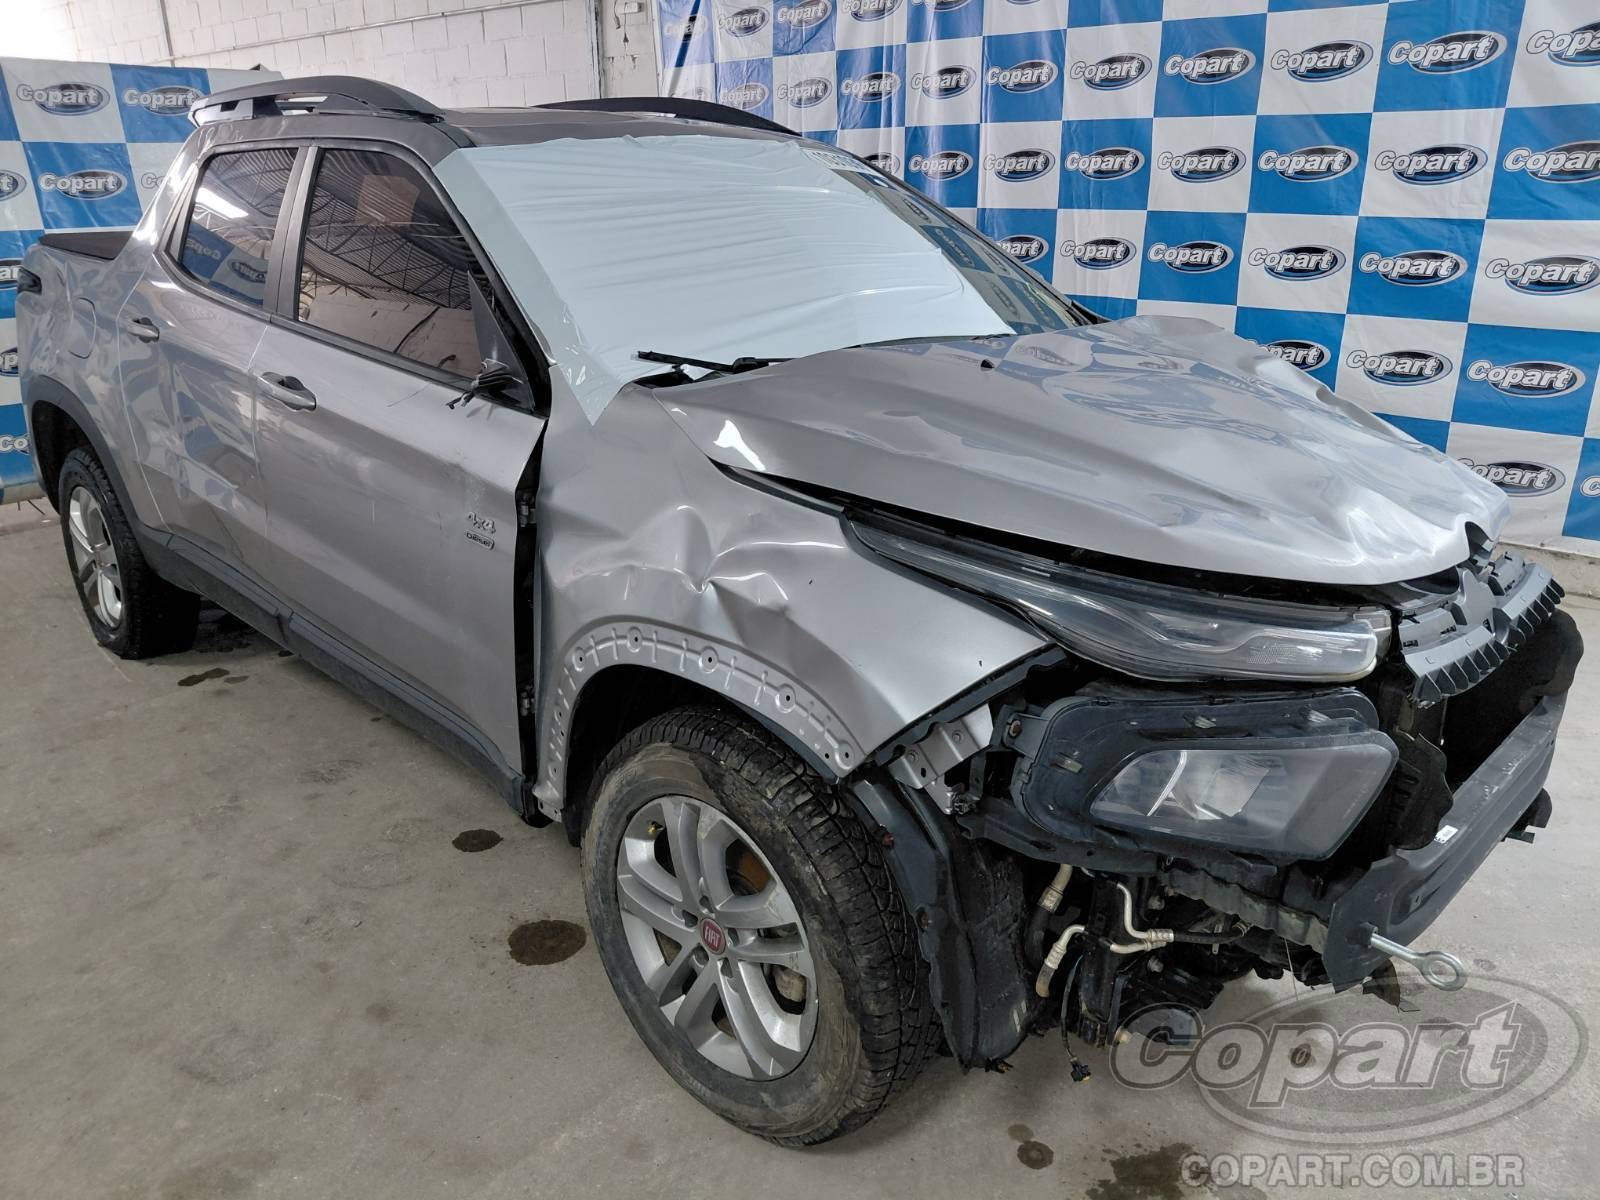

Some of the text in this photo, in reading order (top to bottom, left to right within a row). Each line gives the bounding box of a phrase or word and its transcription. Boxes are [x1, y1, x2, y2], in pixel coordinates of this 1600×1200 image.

[718, 8, 765, 30] Copart
[777, 2, 826, 25] Copart
[1271, 44, 1361, 73] Copart
[1388, 33, 1496, 68] Copart
[985, 63, 1051, 86] Copart
[1070, 56, 1143, 83] Copart
[1164, 50, 1248, 77] Copart
[841, 75, 894, 98] Copart
[911, 69, 969, 91] Copart
[16, 83, 101, 105] Copart
[124, 88, 198, 110] Copart
[777, 82, 826, 104] Copart
[909, 154, 966, 173] Copart
[984, 153, 1049, 174] Copart
[1065, 150, 1139, 175] Copart
[1157, 150, 1237, 173] Copart
[1258, 150, 1349, 174] Copart
[1375, 149, 1474, 175] Copart
[1503, 147, 1600, 176] Copar
[39, 172, 118, 194] Copart
[1060, 240, 1128, 261] Copart
[1148, 242, 1225, 265] Copart
[1248, 248, 1334, 271] Copart
[1359, 253, 1456, 279] Copart
[1485, 258, 1595, 285] Copart
[1346, 350, 1441, 377] Copart
[1467, 360, 1575, 390] Copart
[704, 925, 721, 948] FIAT
